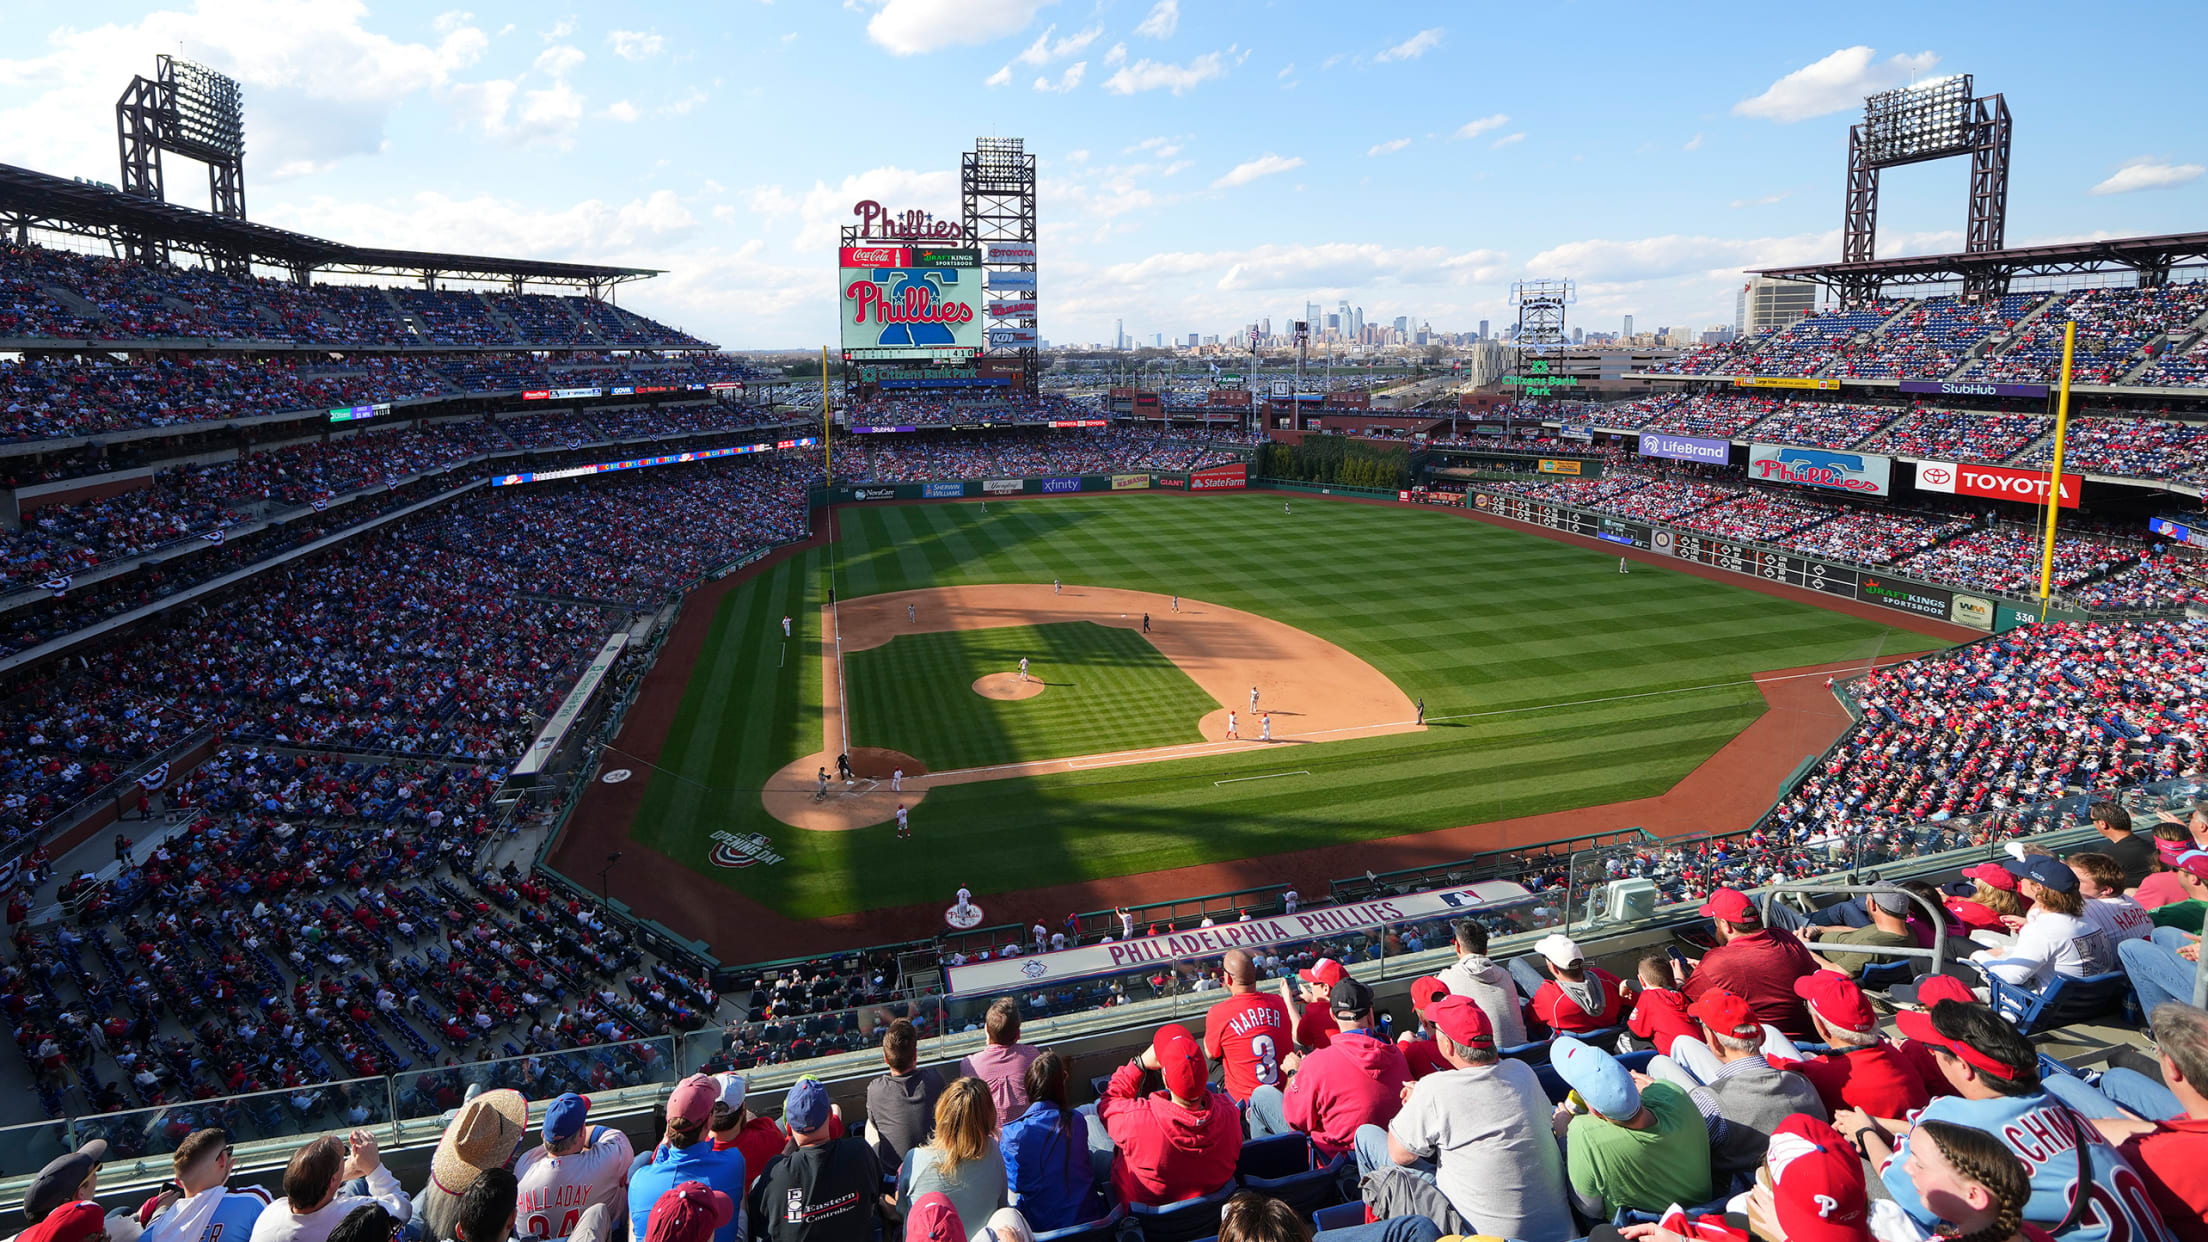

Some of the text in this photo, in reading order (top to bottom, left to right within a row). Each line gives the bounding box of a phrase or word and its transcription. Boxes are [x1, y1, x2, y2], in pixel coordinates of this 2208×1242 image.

[854, 200, 962, 238] Phillies
[853, 249, 890, 262] Coca-Cola
[1000, 249, 1034, 257] TOYOTA
[846, 280, 974, 323] Phillies
[879, 367, 977, 380] Citizens Bank Park
[1502, 376, 1577, 385] Citizens Bank
[1526, 386, 1551, 396] Park
[1941, 382, 1997, 395] StubHub
[1662, 440, 1725, 458] LifeBrand
[1044, 479, 1079, 492] xfinity
[1160, 479, 1184, 487] GIANT
[1753, 458, 1879, 493] Phillies
[1962, 472, 2070, 499] TOYOTA
[866, 488, 895, 496] NovaCare
[1865, 585, 1945, 609] DRAFTKINGS
[1883, 596, 1944, 616] SPORTSBOOK
[2015, 611, 2035, 623] 330
[709, 830, 785, 866] OPENING DAY
[1108, 901, 1404, 966] PHILADELPHIA PHILLIES
[1229, 1007, 1280, 1036] HARPER
[1252, 1034, 1279, 1085] 3
[518, 1184, 593, 1214] HALLADAY
[805, 1192, 856, 1213] Eastern
[1813, 1194, 1838, 1218] P
